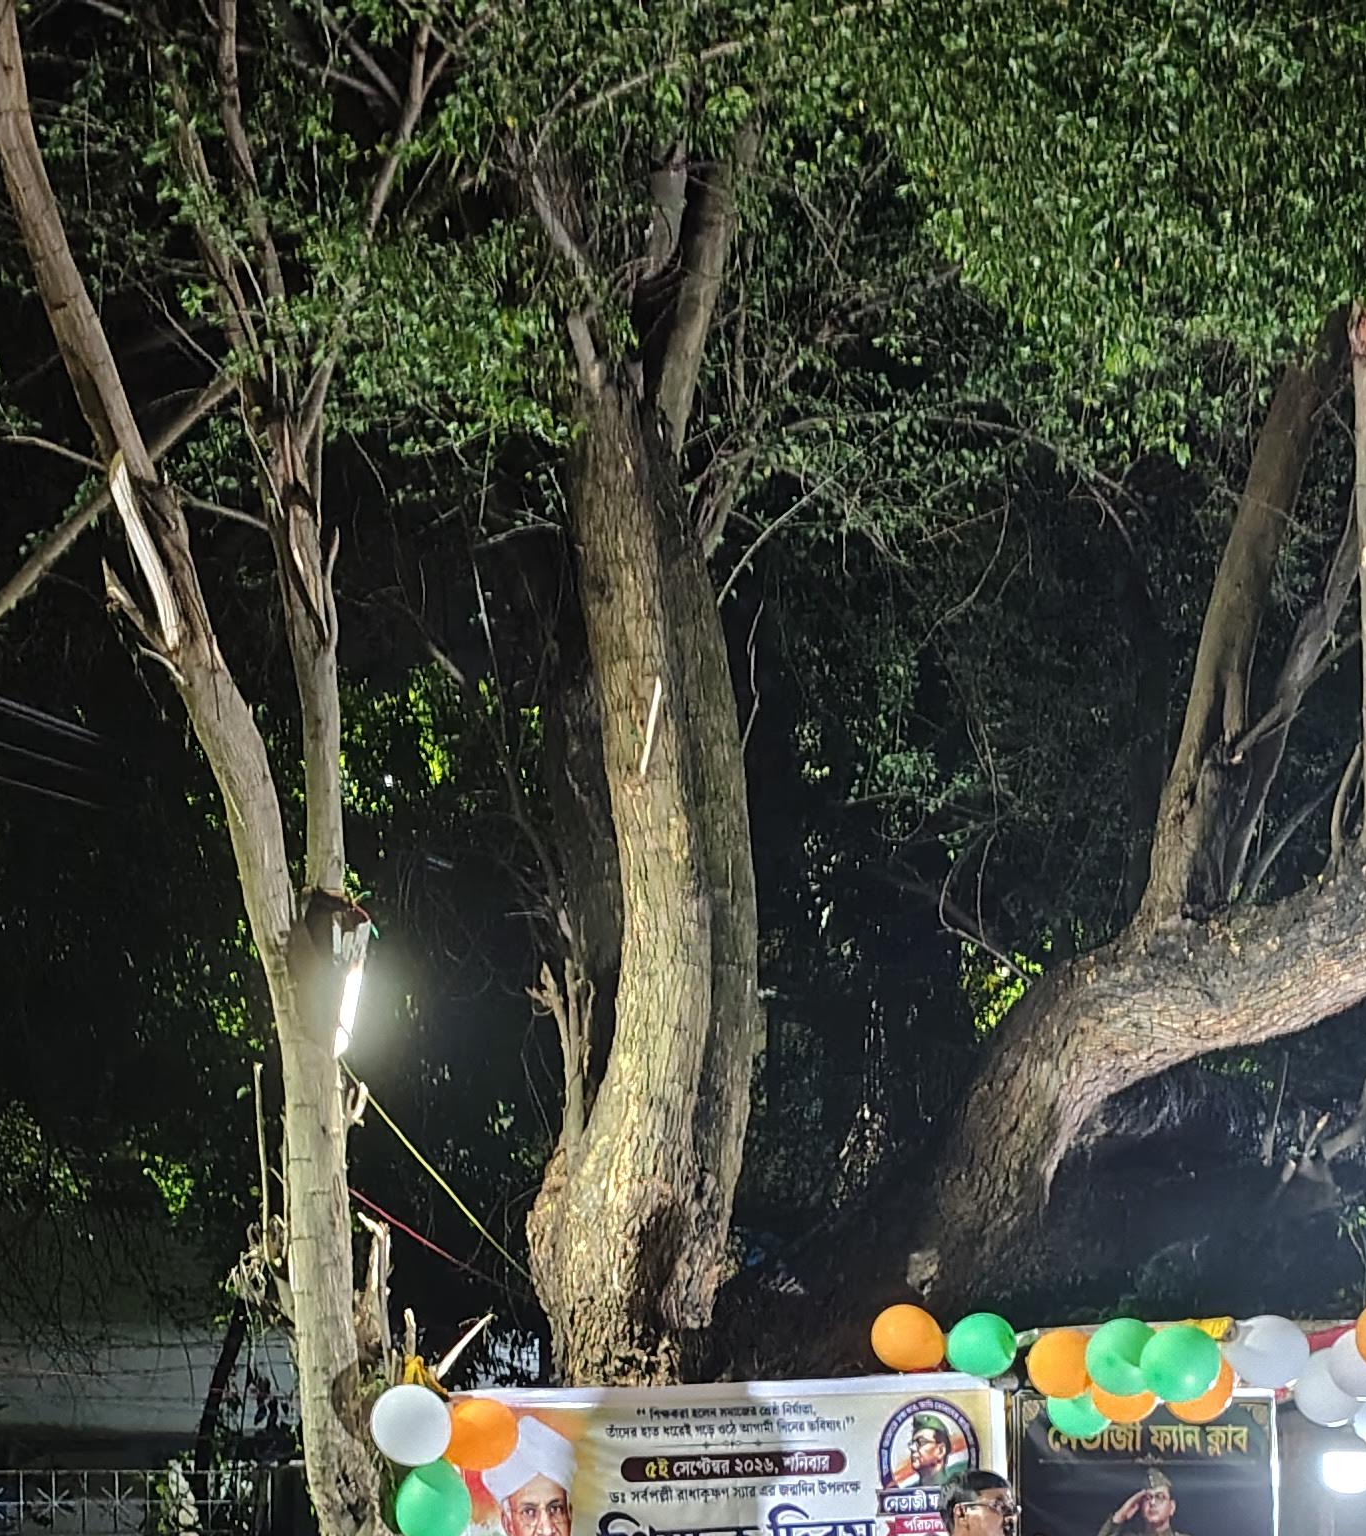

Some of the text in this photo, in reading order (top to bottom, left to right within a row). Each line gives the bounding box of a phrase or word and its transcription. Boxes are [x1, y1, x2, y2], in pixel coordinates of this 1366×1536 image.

[1149, 1423, 1201, 1453] ফ্যান
[1206, 1422, 1249, 1458] ক্লাব
[644, 1457, 670, 1479] ৫ই
[782, 1451, 830, 1473] শনিবার
